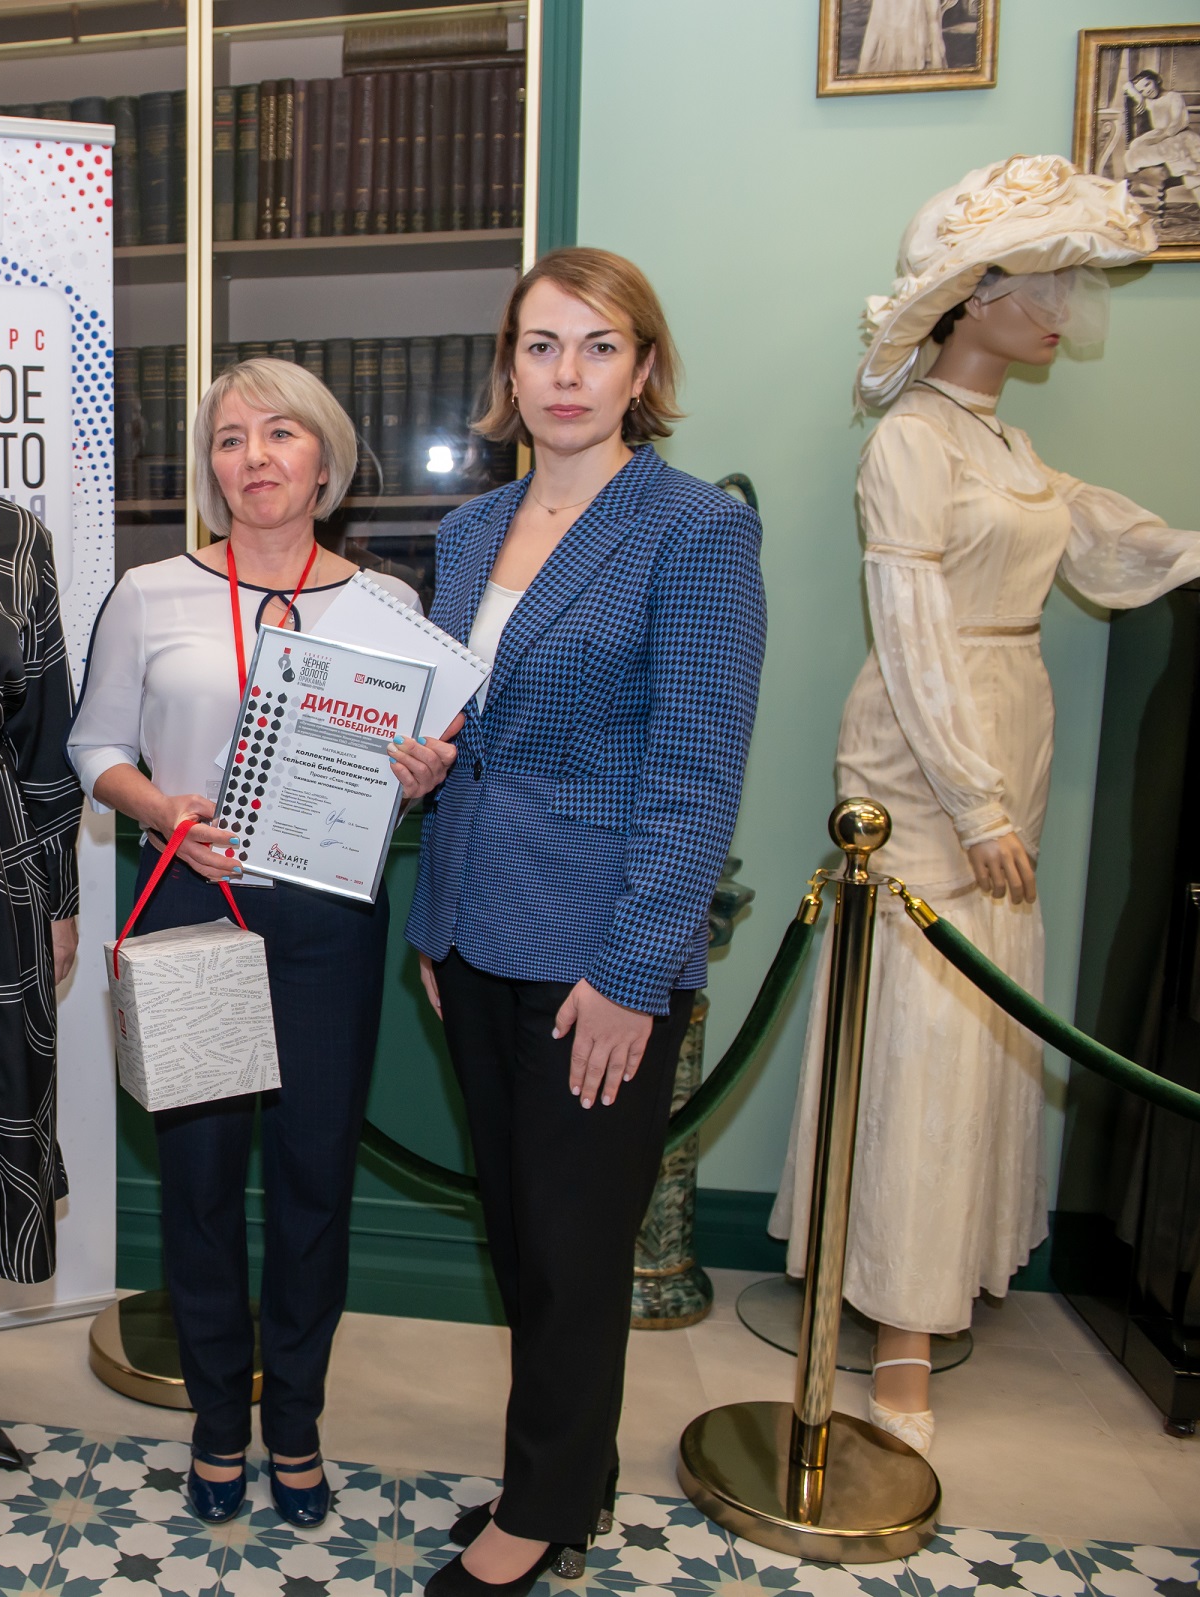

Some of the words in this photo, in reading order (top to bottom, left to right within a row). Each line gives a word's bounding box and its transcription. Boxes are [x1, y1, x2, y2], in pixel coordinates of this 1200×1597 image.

[300, 667, 328, 680] ЗОЛОТО
[365, 677, 406, 692] ЛУКОЙЛ
[300, 693, 398, 733] ДИПЛОМ
[329, 716, 396, 740] ПОБЕДИТЕЛЯ
[296, 750, 334, 762] коллектив
[336, 758, 379, 773] Ножовской
[283, 757, 316, 768] сельской
[318, 764, 387, 786] библиотеки-музея
[267, 858, 306, 870] КРЕАТИВ
[268, 849, 308, 865] КАЧАЙТЕ
